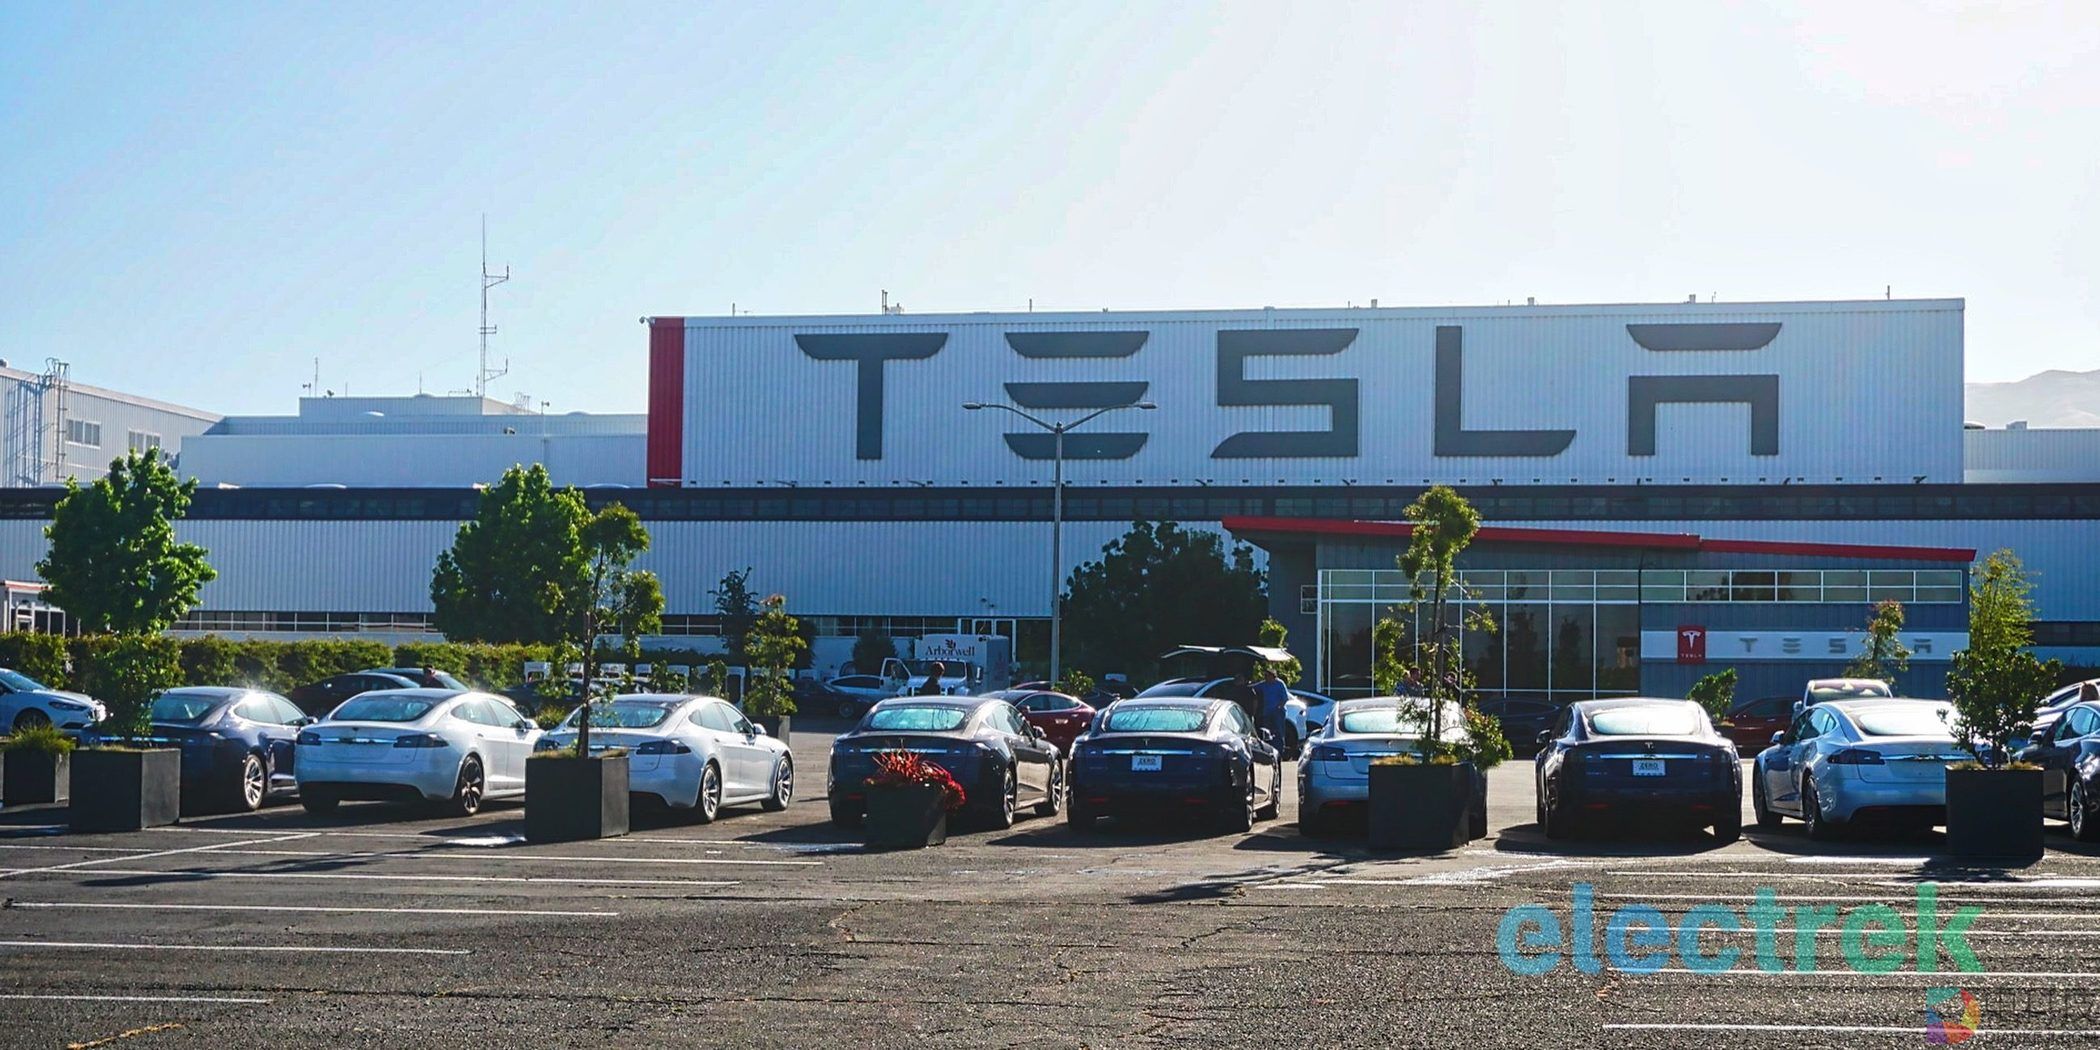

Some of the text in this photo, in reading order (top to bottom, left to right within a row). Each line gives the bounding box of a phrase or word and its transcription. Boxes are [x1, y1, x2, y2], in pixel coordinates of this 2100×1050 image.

[794, 323, 1781, 461] TESLA
[925, 645, 975, 656] Arborwell
[1739, 637, 1932, 654] TESA
